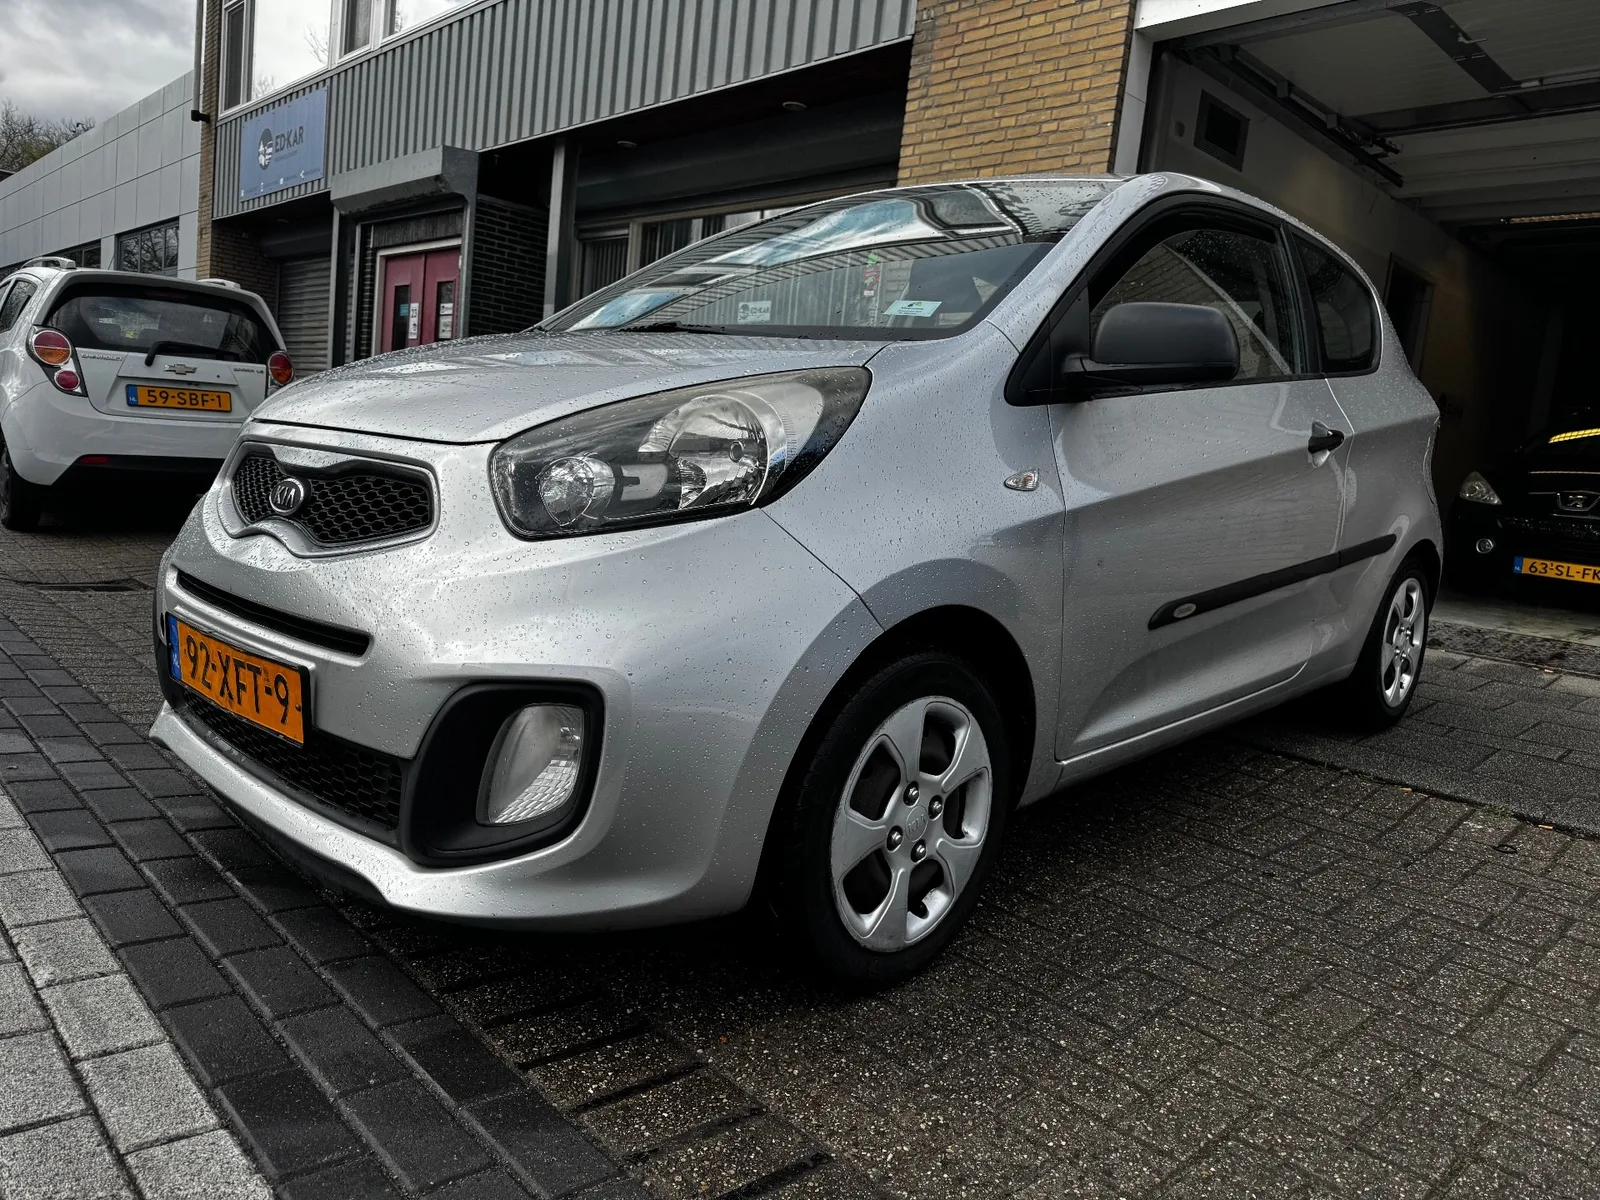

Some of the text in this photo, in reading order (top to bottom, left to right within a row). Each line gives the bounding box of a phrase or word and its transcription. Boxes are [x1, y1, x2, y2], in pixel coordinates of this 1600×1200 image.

[147, 389, 222, 408] 59-SBF-1
[273, 485, 296, 507] KIA
[1528, 561, 1600, 581] 63-SL-FK
[186, 634, 289, 726] 92-XFT-9
